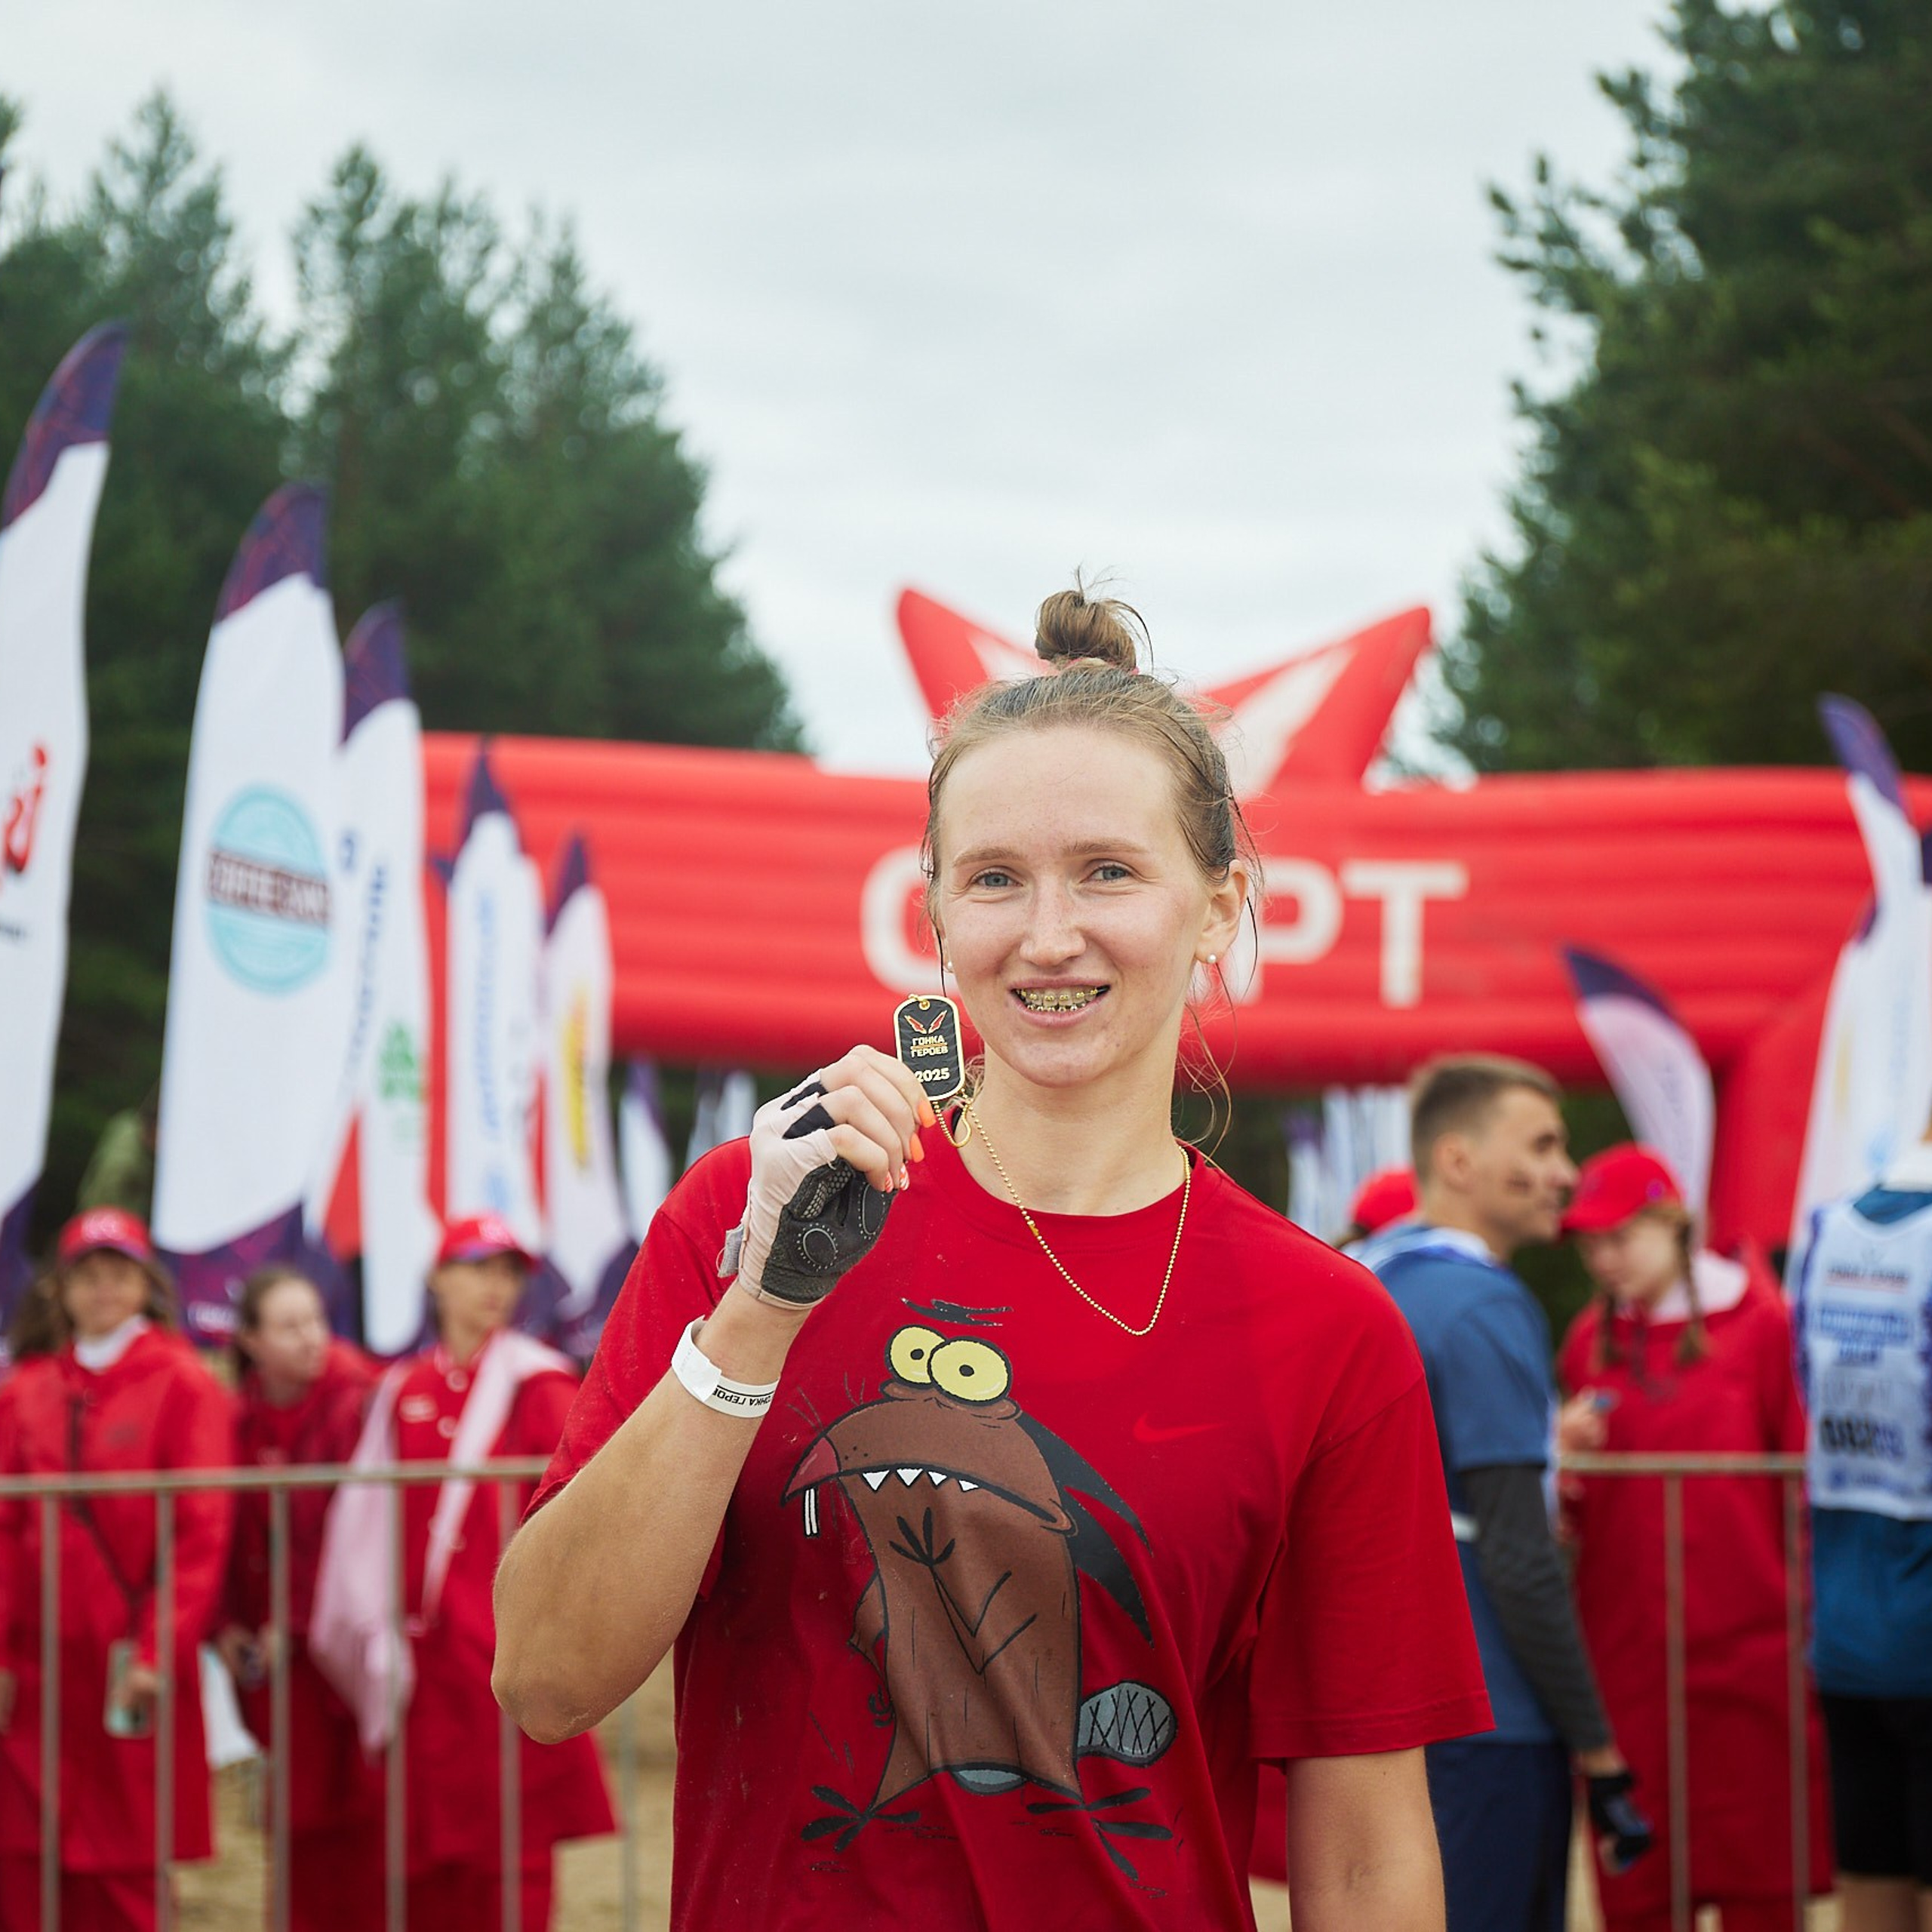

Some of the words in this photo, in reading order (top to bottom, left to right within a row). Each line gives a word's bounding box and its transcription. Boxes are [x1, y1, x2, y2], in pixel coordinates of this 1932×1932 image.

[860, 844, 1469, 1009] СРТ
[912, 1035, 945, 1046] ГОНКА
[911, 1046, 949, 1057] ГЕРОЕВ
[915, 1067, 950, 1082] 2025
